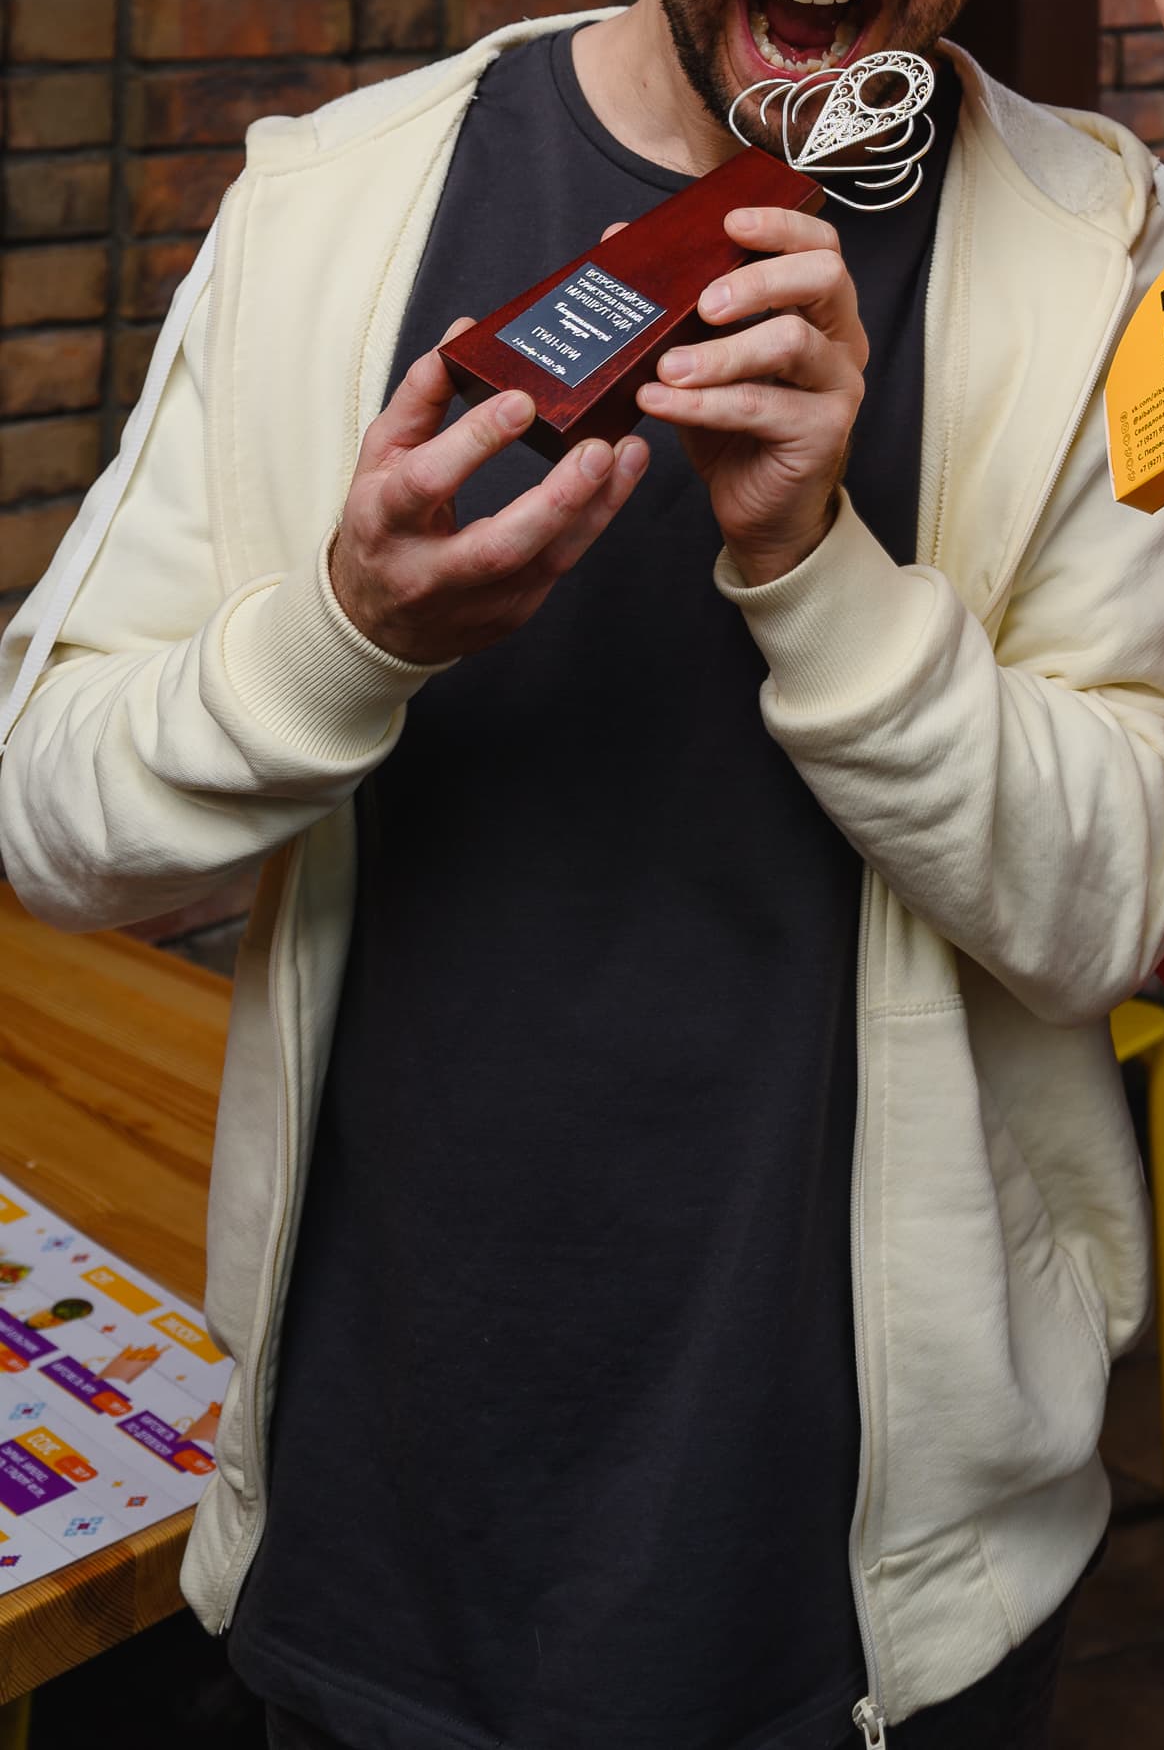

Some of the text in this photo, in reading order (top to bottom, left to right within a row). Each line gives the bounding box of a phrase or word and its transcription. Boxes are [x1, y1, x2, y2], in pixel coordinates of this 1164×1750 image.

[564, 284, 633, 332] МАРШРУТ ГОДА
[585, 268, 656, 315] ВСЕРОССИЙСКАЯ
[531, 326, 582, 361] ГРАН-ПРИ
